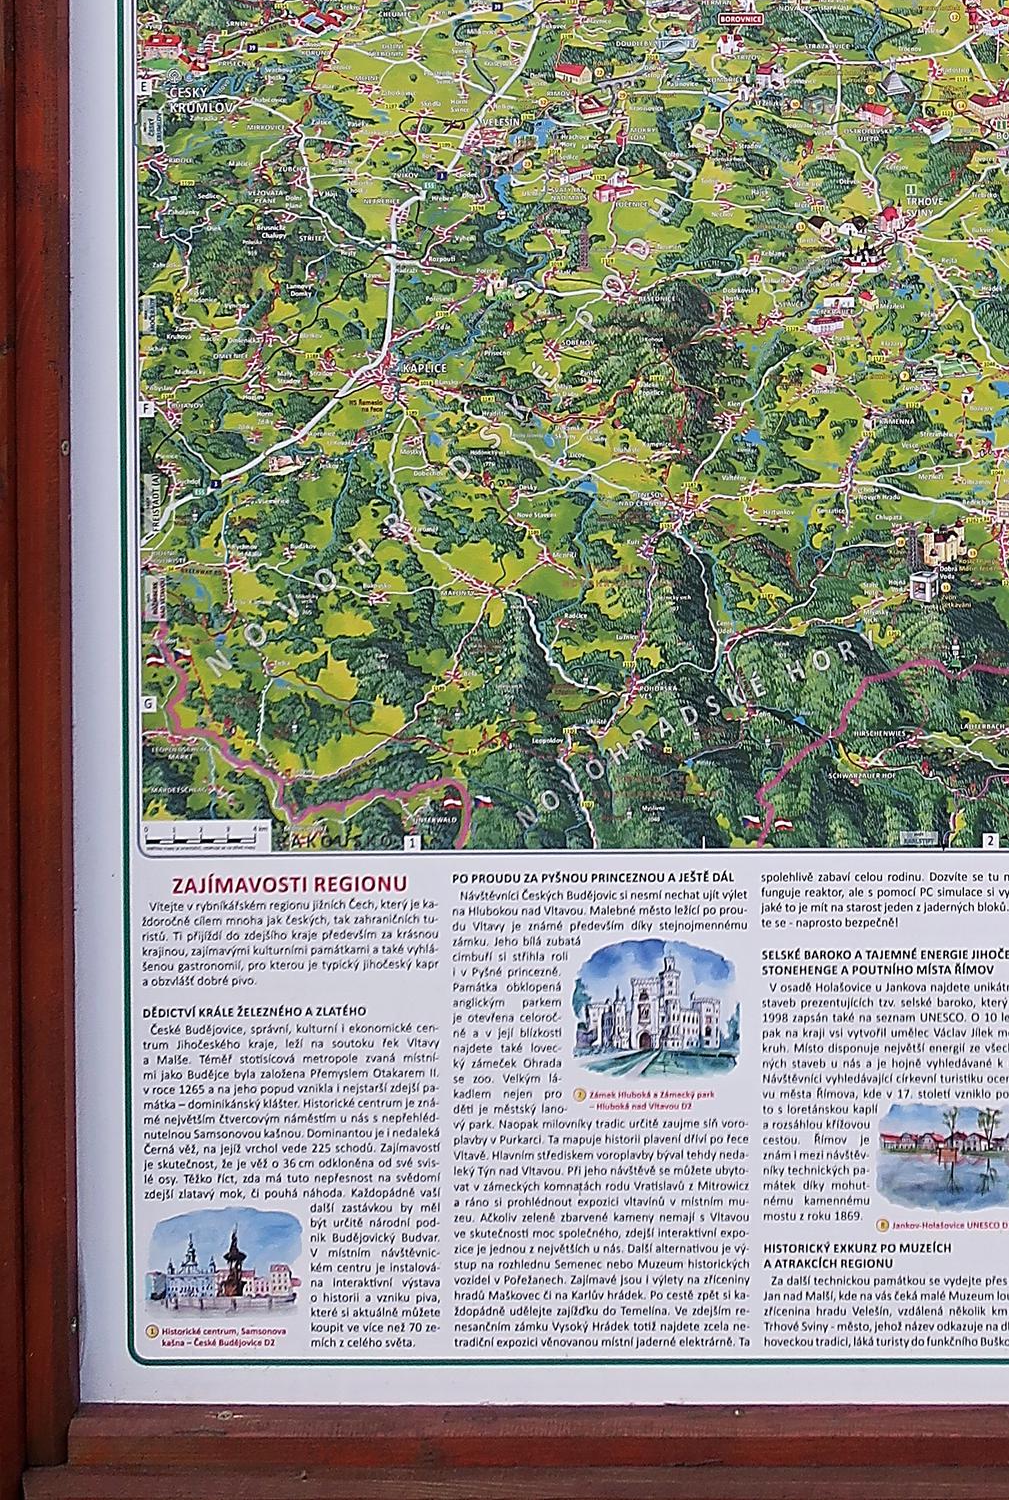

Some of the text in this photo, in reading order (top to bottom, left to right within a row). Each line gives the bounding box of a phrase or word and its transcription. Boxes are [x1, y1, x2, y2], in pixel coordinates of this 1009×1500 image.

[172, 873, 406, 894] ZAJÍMAVOSTI REGIONU
[452, 870, 734, 884] PO PROUDU ZA PYŠNOU PRINCEZNOU A JEŠTĚ DÁL
[762, 948, 800, 960] SELSKÉ
[804, 950, 852, 960] BAROKO
[854, 950, 862, 960] A
[865, 947, 917, 960] TAJEMNÉ
[920, 950, 968, 960] ENERGIE
[762, 962, 994, 975] STONEHENGE A POUTNÍHO MÍSTA ŘÍMOV
[143, 1004, 366, 1018] DĚDICTVÍ KRÁLE ŽELEZNÉHO A ZLATÉHO
[764, 1240, 951, 1254] HISTORICKÝ EXKURZ PO MUZEÍCH
[764, 1256, 893, 1269] A ATRAKCÍCH REGIONU
